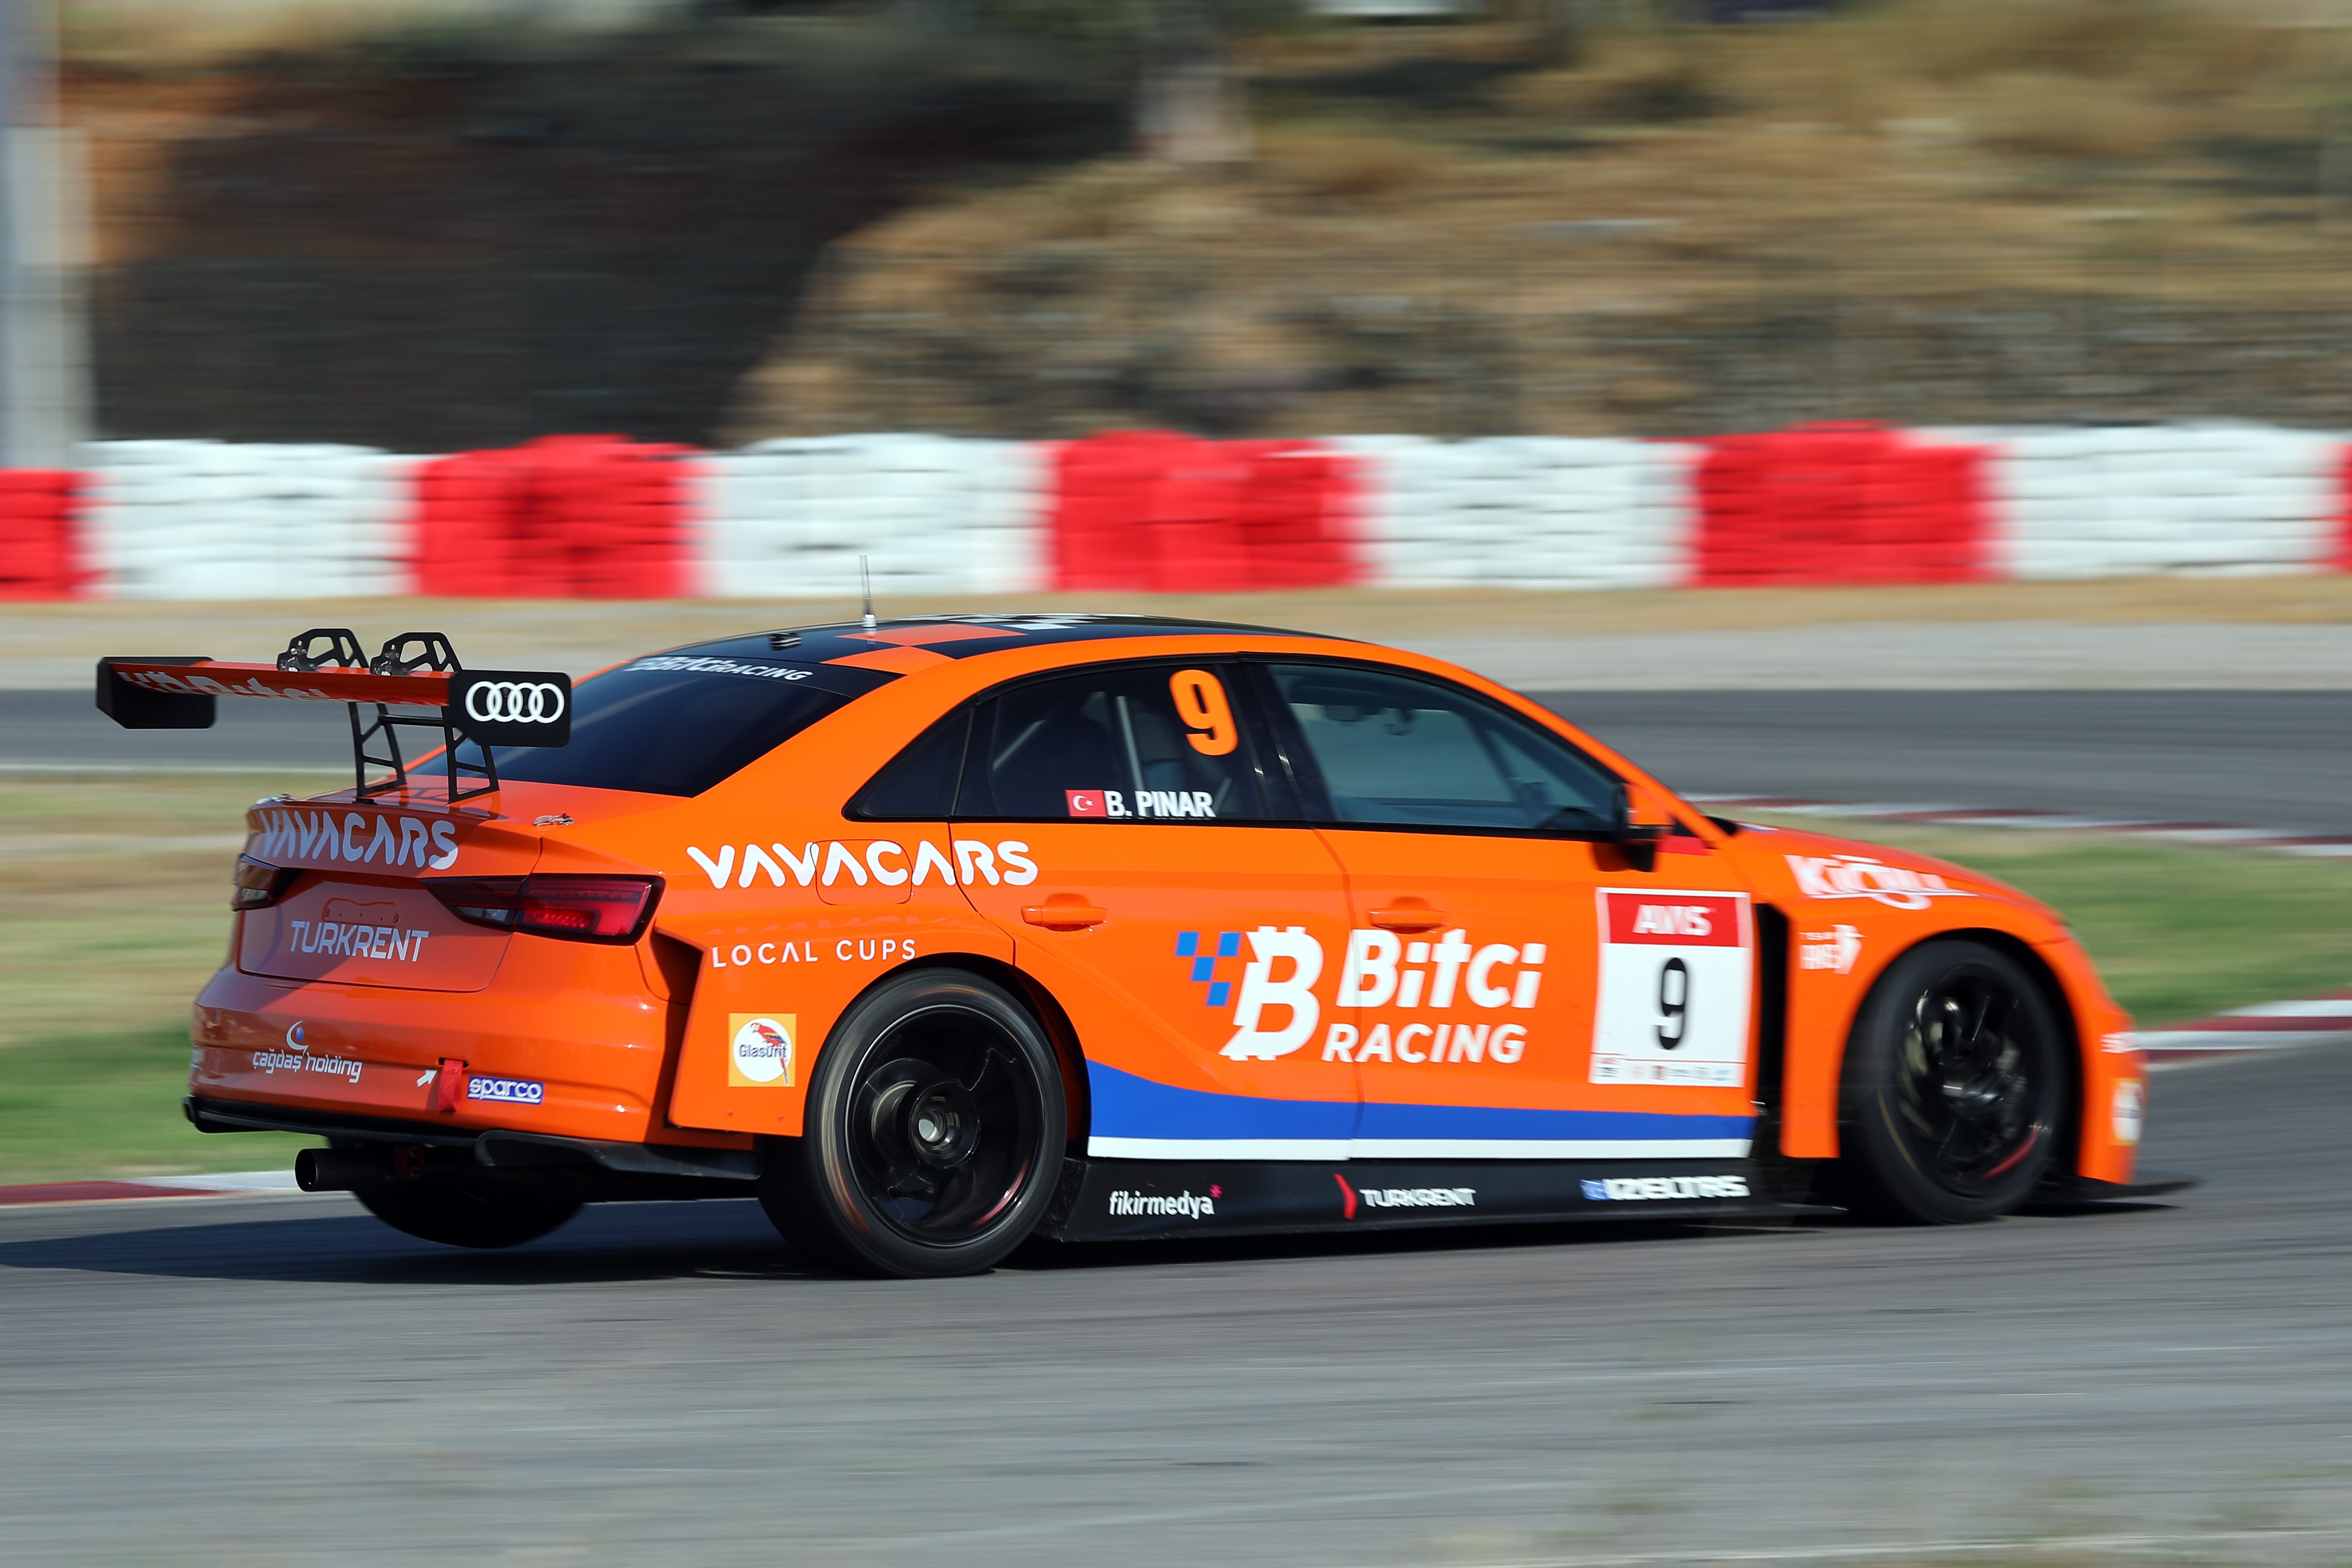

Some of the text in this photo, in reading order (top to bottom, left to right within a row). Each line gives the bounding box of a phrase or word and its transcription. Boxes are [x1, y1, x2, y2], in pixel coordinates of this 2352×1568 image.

[711, 663, 813, 680] RACING
[1169, 670, 1238, 756] 9
[1104, 790, 1217, 818] B. PINAR
[258, 811, 459, 870] VAVACARS
[687, 840, 1039, 889] VAVACARS
[290, 921, 430, 962] TURKRENT
[712, 939, 917, 968] LOCAL CUPS
[1335, 928, 1547, 1009] Bitci
[1652, 957, 1694, 1051] 9
[1321, 1023, 1528, 1064] RACING
[305, 1052, 363, 1084] holding
[469, 1078, 542, 1100] sparco
[1109, 1190, 1215, 1220] fikirmedya
[1359, 1188, 1477, 1207] TURKRENT
